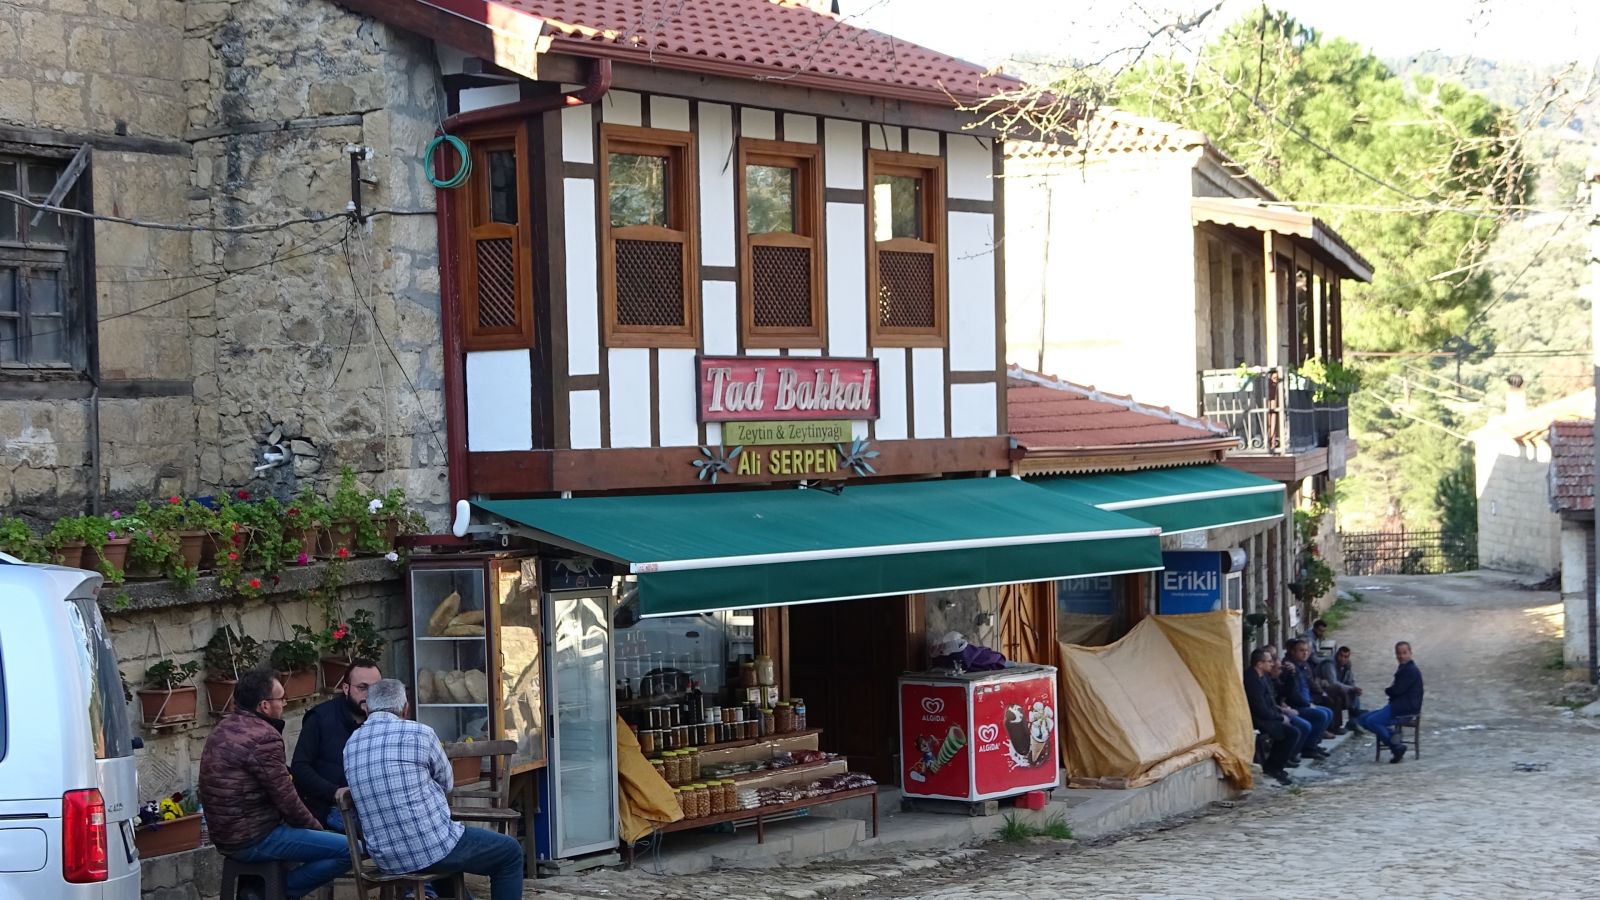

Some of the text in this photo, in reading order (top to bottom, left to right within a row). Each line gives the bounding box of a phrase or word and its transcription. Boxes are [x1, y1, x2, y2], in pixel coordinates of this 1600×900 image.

[707, 367, 872, 412] Tad Bakkal
[738, 423, 842, 444] Zeytin & Zeytinyağı
[737, 448, 837, 475] Ali SERPEN
[1163, 570, 1217, 590] Erikli
[921, 714, 945, 722] ALGIDA
[978, 743, 1000, 753] ALGIDA
